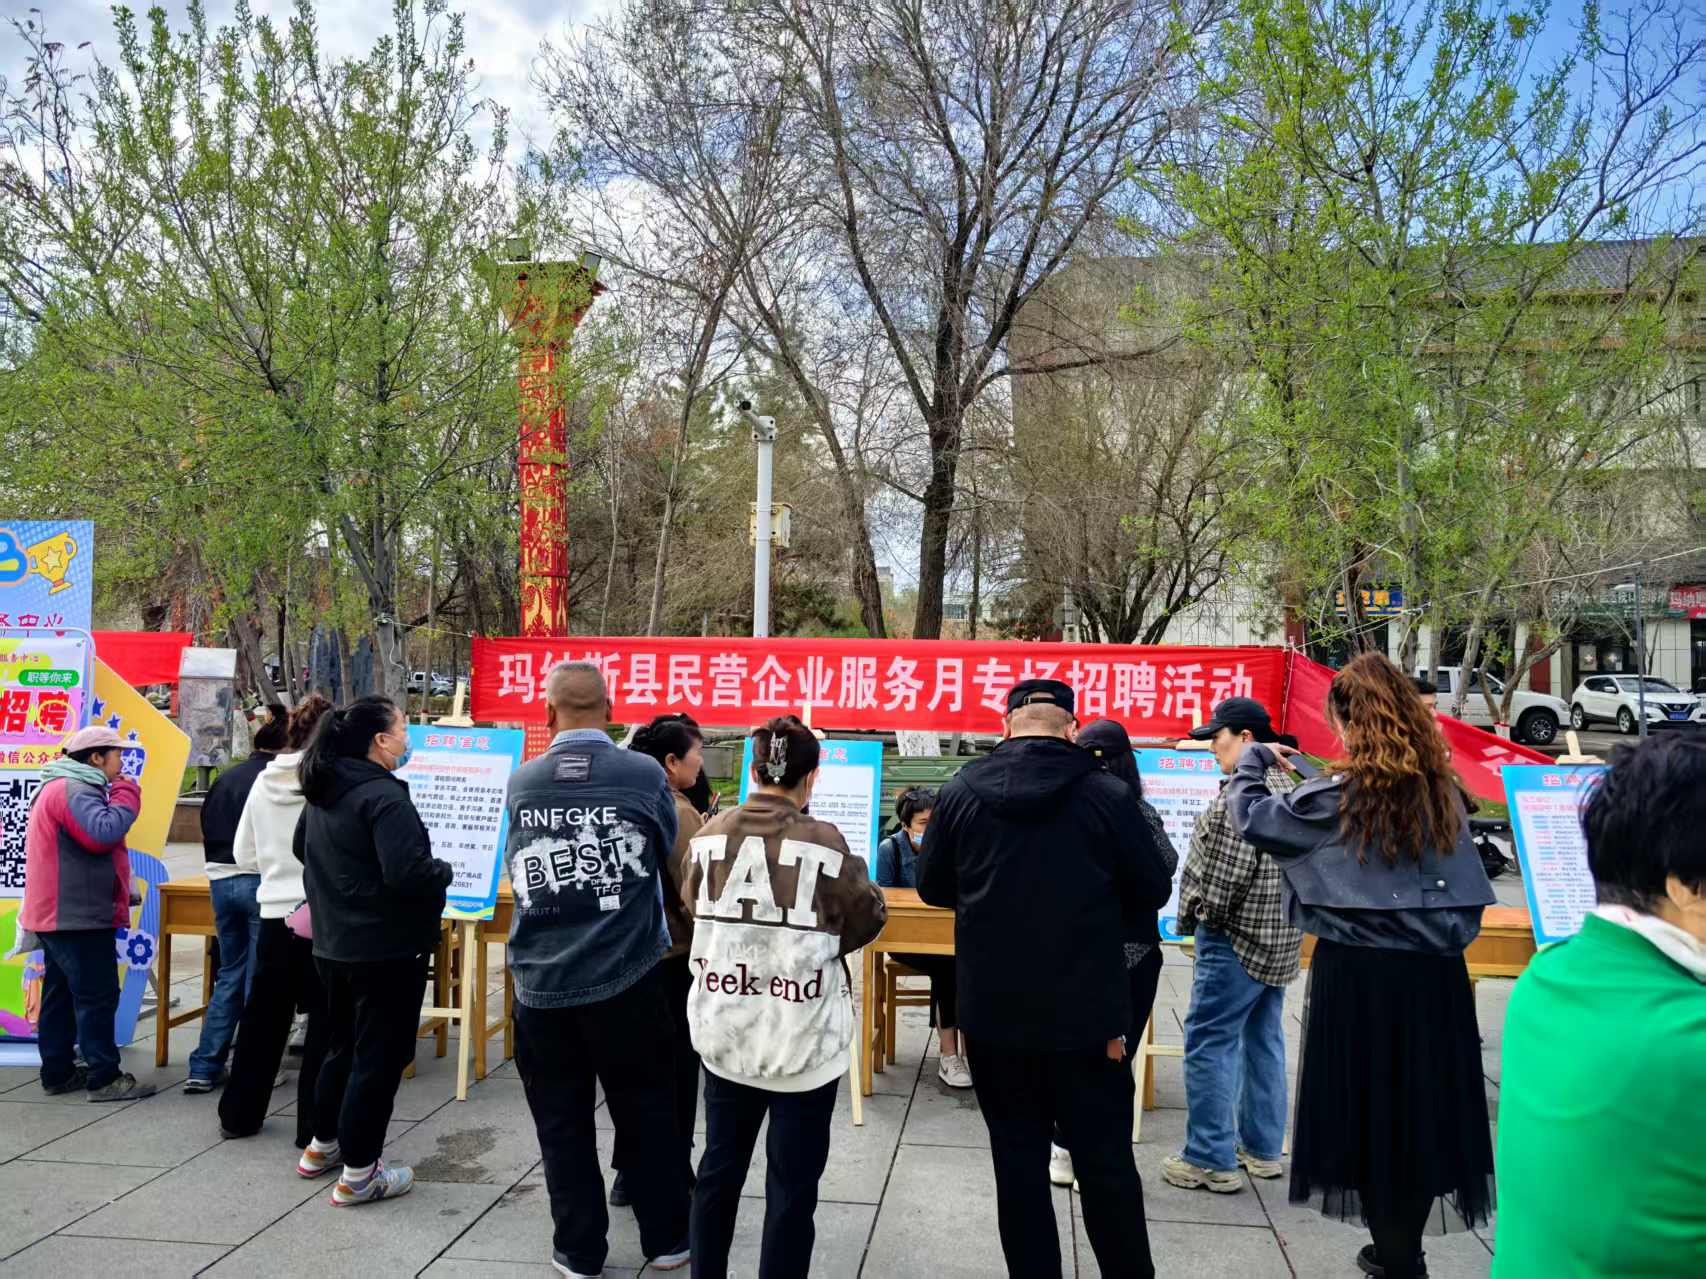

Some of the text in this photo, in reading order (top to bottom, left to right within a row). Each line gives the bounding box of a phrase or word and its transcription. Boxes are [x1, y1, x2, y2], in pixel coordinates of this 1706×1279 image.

[498, 650, 1253, 720] 玛斯县民营企业服务月专招聘活动
[0, 690, 70, 733] 招聘
[523, 836, 625, 890] BEST
[770, 968, 824, 1003] end
